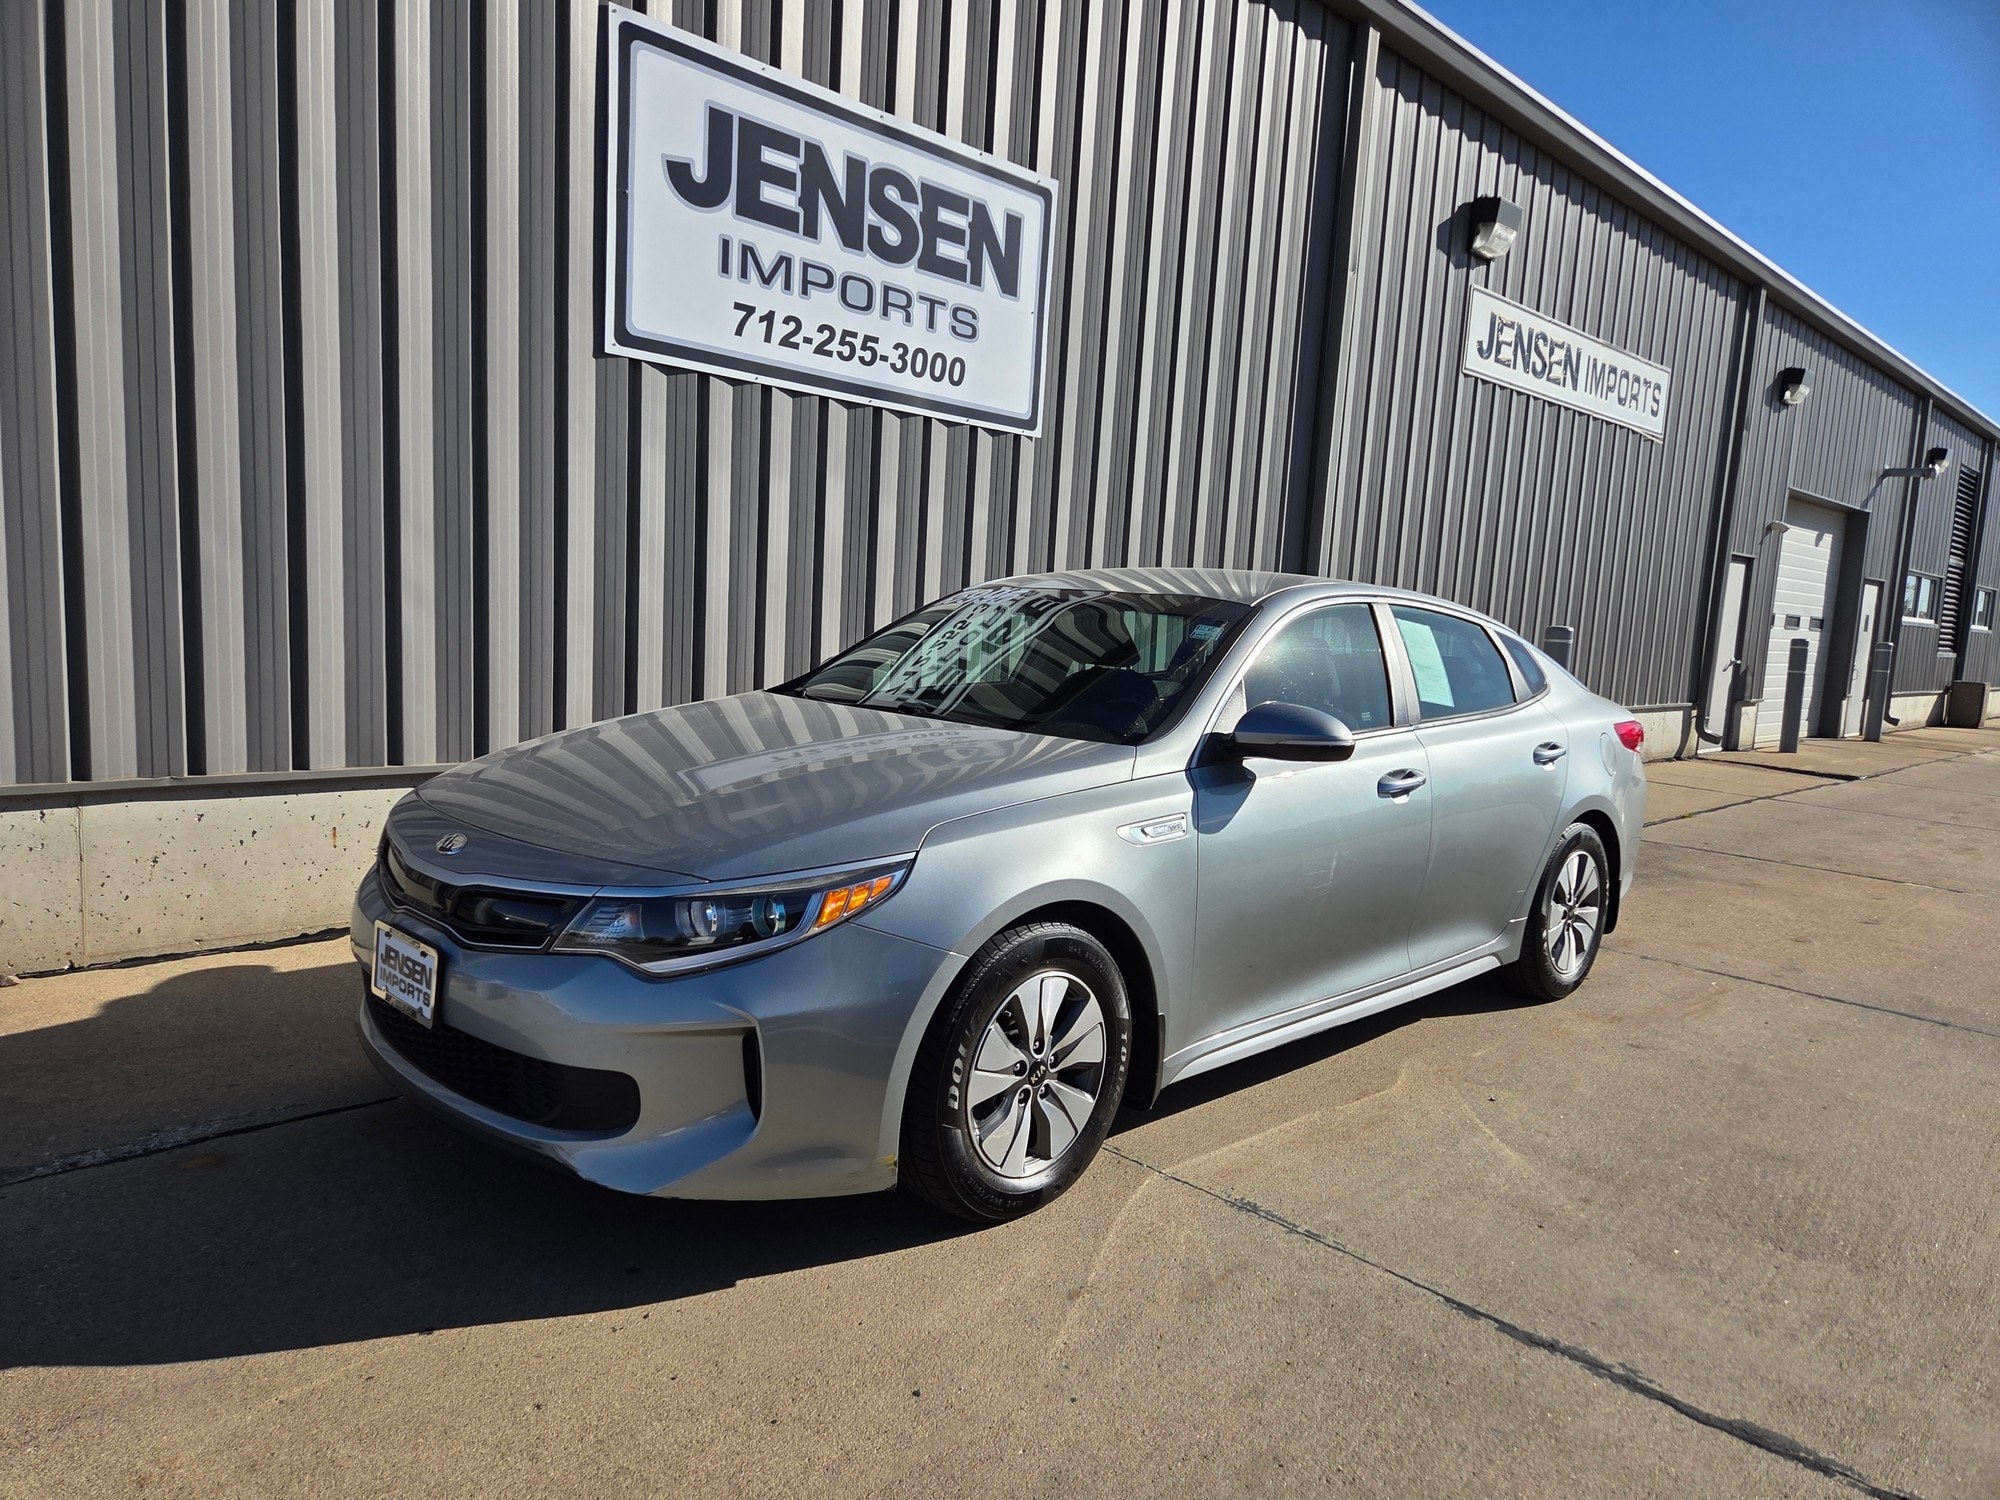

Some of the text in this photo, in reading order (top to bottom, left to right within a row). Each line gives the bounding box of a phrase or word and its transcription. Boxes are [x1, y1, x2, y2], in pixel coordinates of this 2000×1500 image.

[663, 101, 1024, 300] JENSEN
[719, 235, 979, 342] IMPORTS
[732, 301, 967, 387] 712-255-3000
[1477, 311, 1662, 418] JENSEN IMPORTS
[379, 966, 432, 1008] IMPORTS
[381, 943, 433, 990] JENSEN
[1030, 1064, 1046, 1084] KIA
